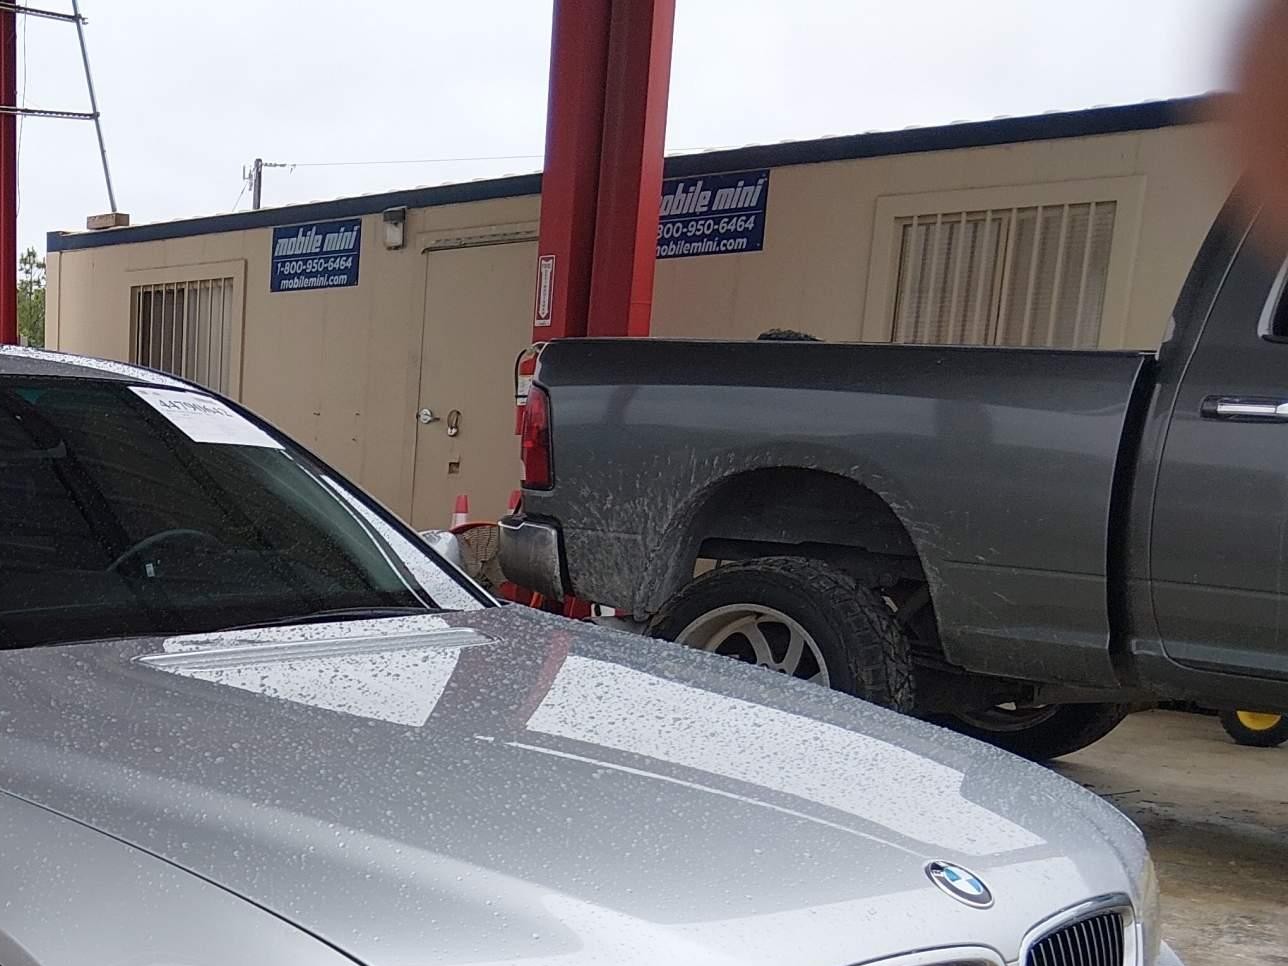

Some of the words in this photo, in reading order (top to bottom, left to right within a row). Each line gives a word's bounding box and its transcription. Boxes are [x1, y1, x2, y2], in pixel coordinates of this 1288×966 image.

[660, 180, 711, 216] obile
[712, 179, 764, 211] mini
[657, 215, 755, 239] 800-950-6464
[275, 226, 322, 256] mobile
[323, 225, 358, 252] mini
[277, 257, 352, 275] 1-800-950-6464
[280, 274, 347, 289] mobilemini.com
